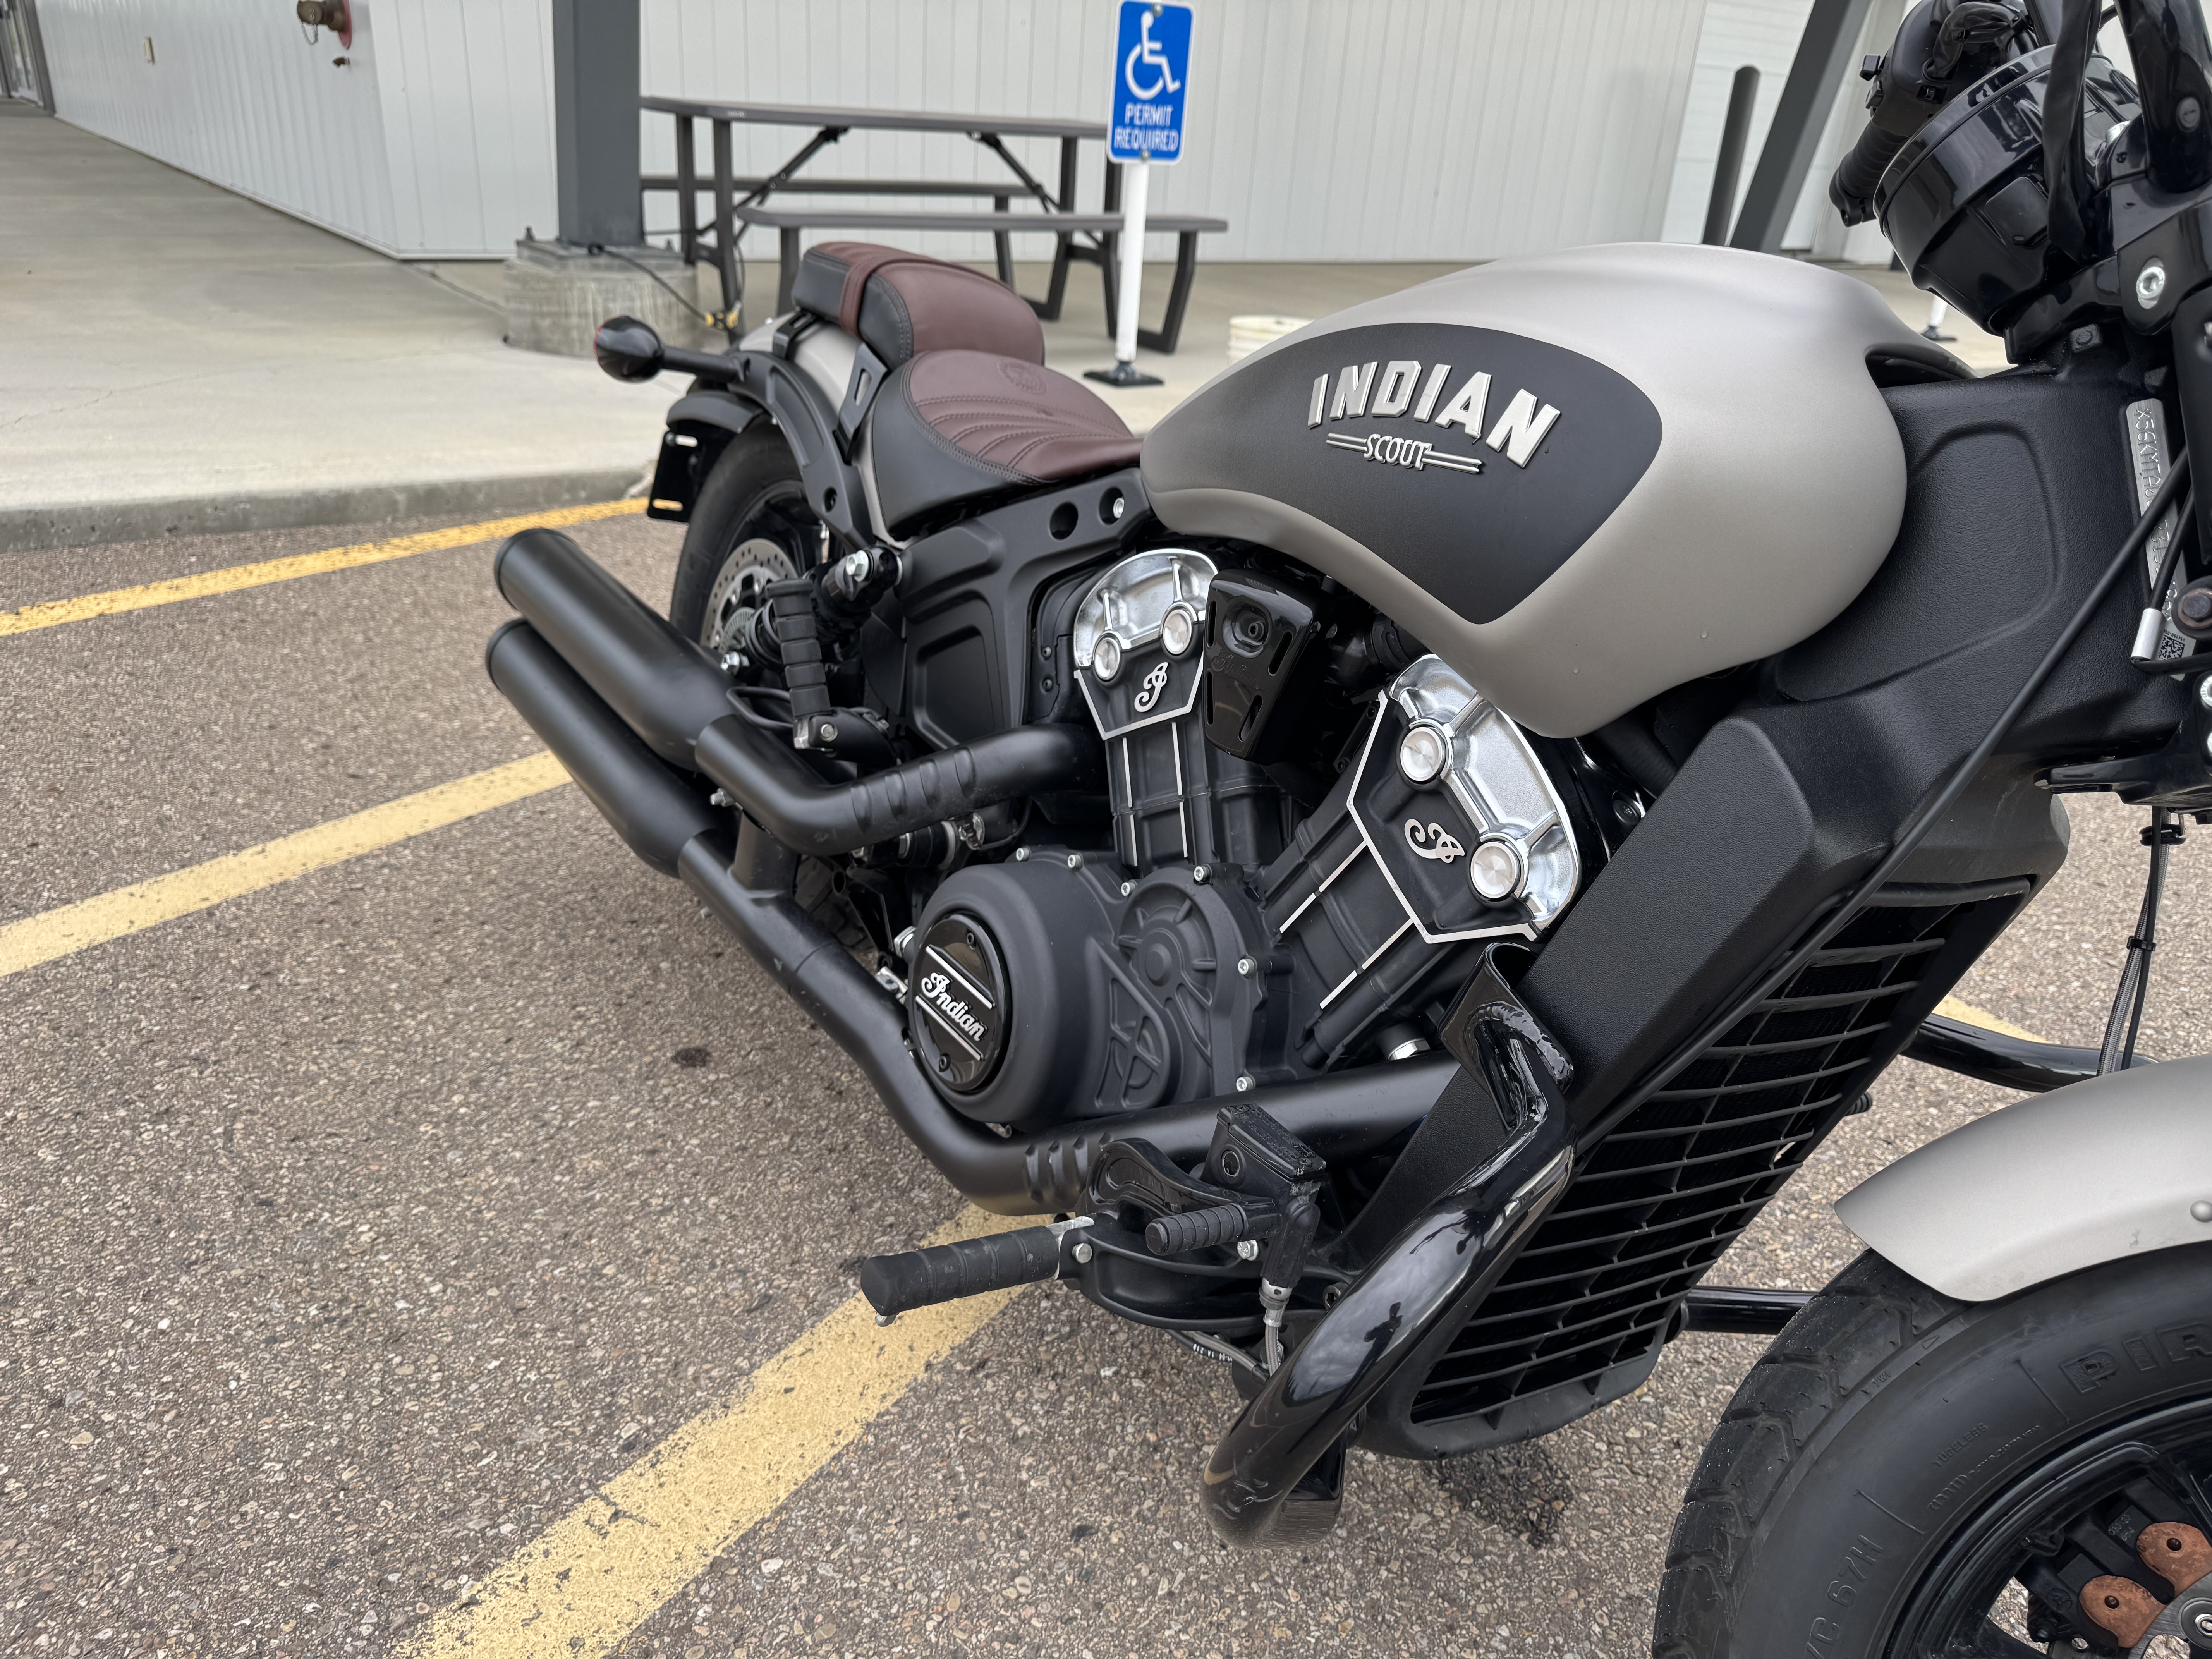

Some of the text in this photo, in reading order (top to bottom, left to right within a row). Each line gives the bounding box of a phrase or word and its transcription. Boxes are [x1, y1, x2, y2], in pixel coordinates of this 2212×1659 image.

[1125, 103, 1173, 127] PERMIT
[1114, 126, 1179, 151] REQUIRED
[1308, 361, 1560, 469] INDIAN
[1364, 433, 1433, 470] SCOUT
[921, 972, 986, 1041] Indian
[1872, 1370, 1891, 1387] TWI
[2059, 1324, 2212, 1393] PIR
[1932, 1422, 1989, 1467] TUBELESS
[1827, 1535, 1884, 1607] 67H
